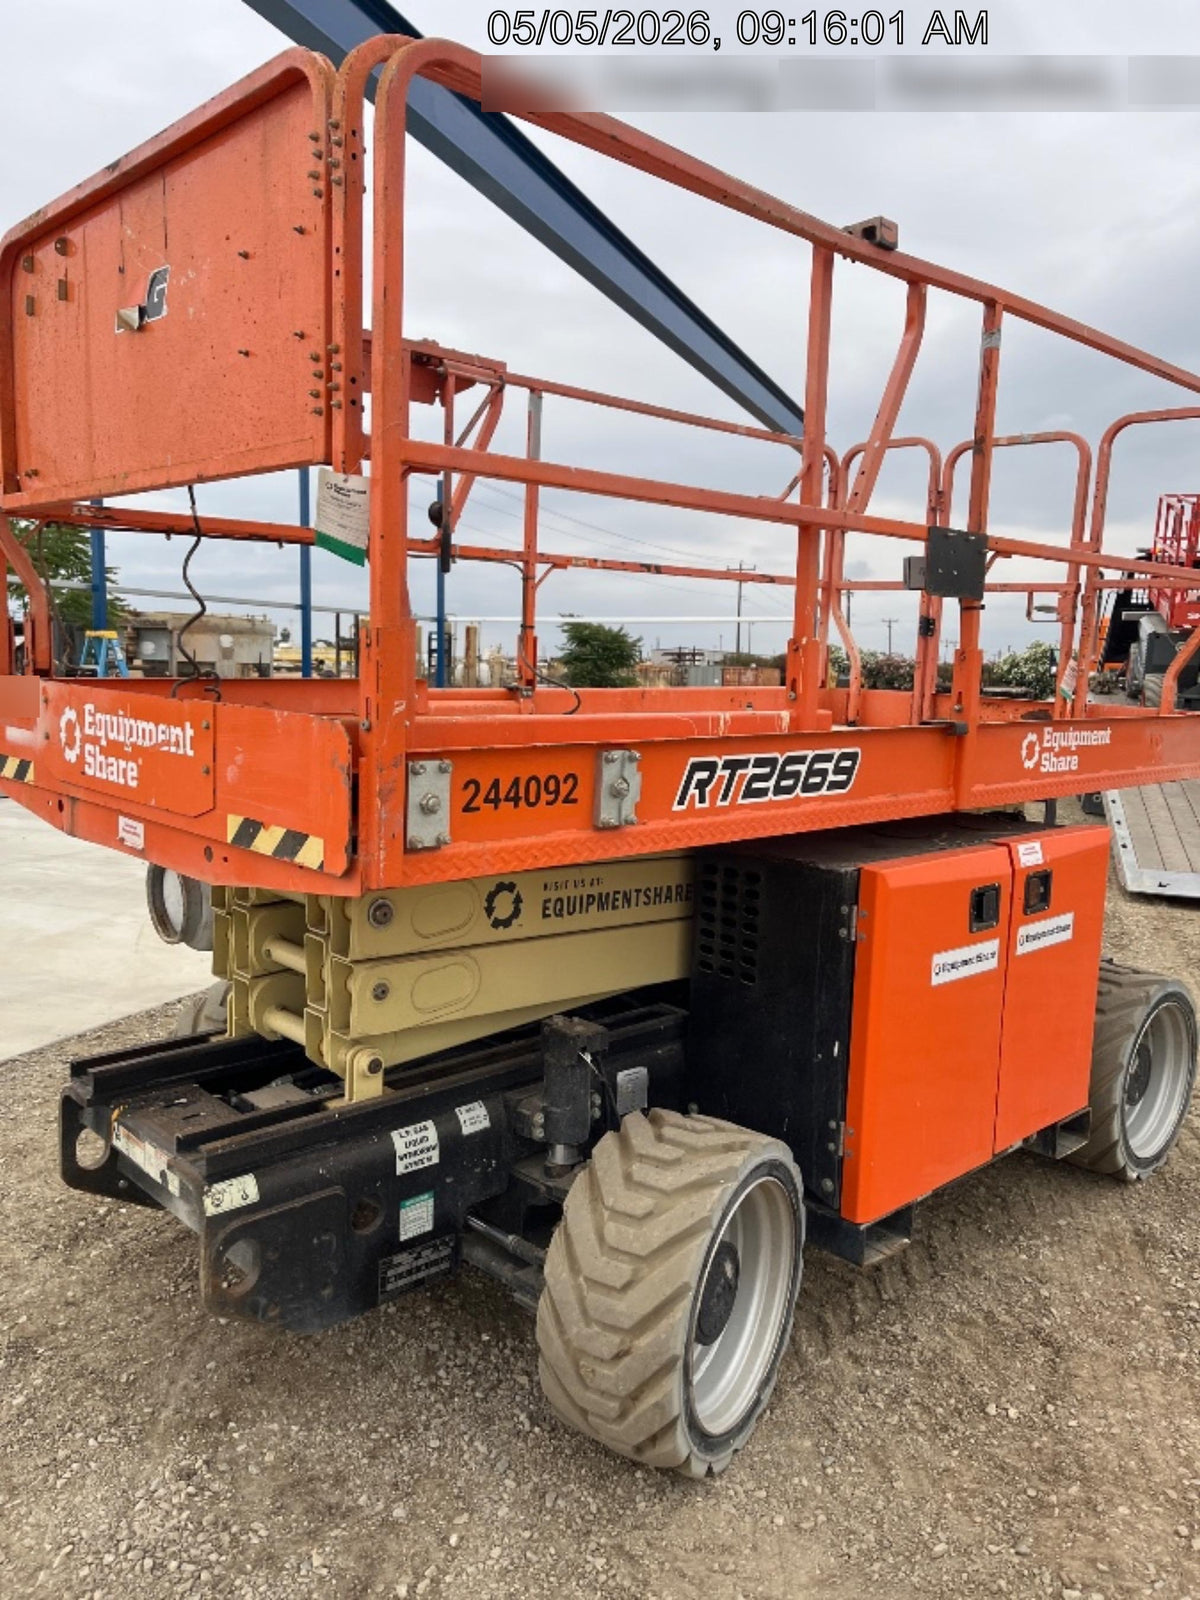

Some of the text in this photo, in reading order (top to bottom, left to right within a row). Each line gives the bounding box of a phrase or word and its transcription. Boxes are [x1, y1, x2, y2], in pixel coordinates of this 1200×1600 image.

[83, 703, 194, 757] Equipment
[1042, 726, 1112, 752] Equipment
[84, 743, 139, 788] Share
[672, 747, 861, 811] RT2669
[1040, 752, 1079, 773] Share
[461, 773, 579, 813] 244092
[541, 883, 693, 919] EQUIPMENTSHARE
[573, 879, 586, 890] US
